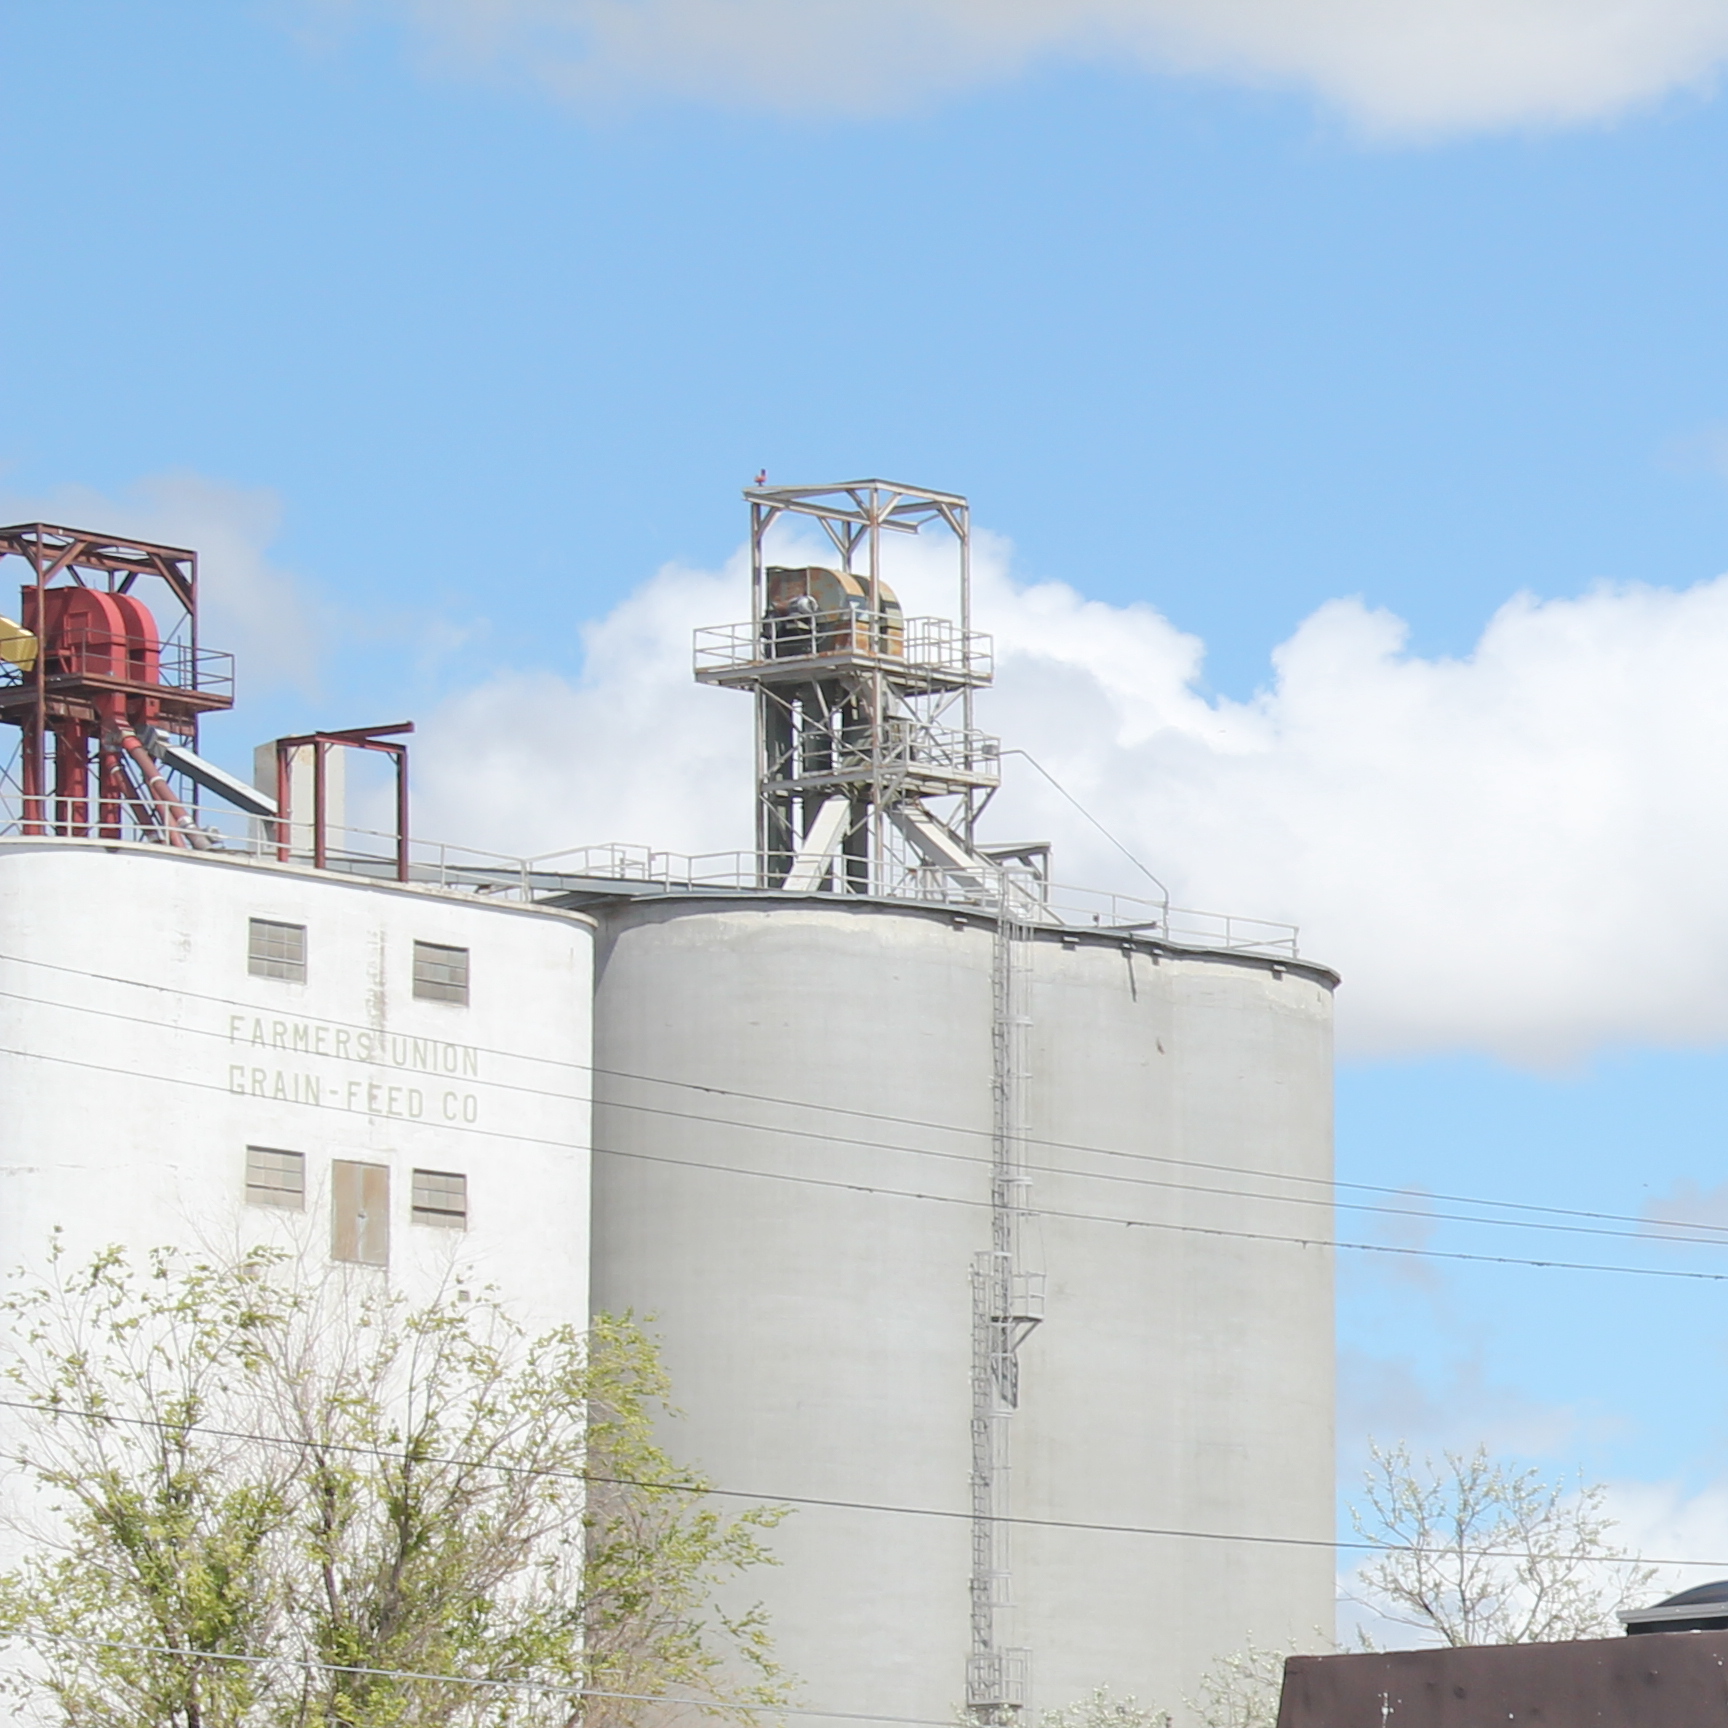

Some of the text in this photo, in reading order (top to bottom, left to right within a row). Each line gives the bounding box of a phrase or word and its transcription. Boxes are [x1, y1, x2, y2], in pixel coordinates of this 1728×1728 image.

[229, 1014, 479, 1077] FARMERS UNION
[442, 1091, 478, 1123] CO
